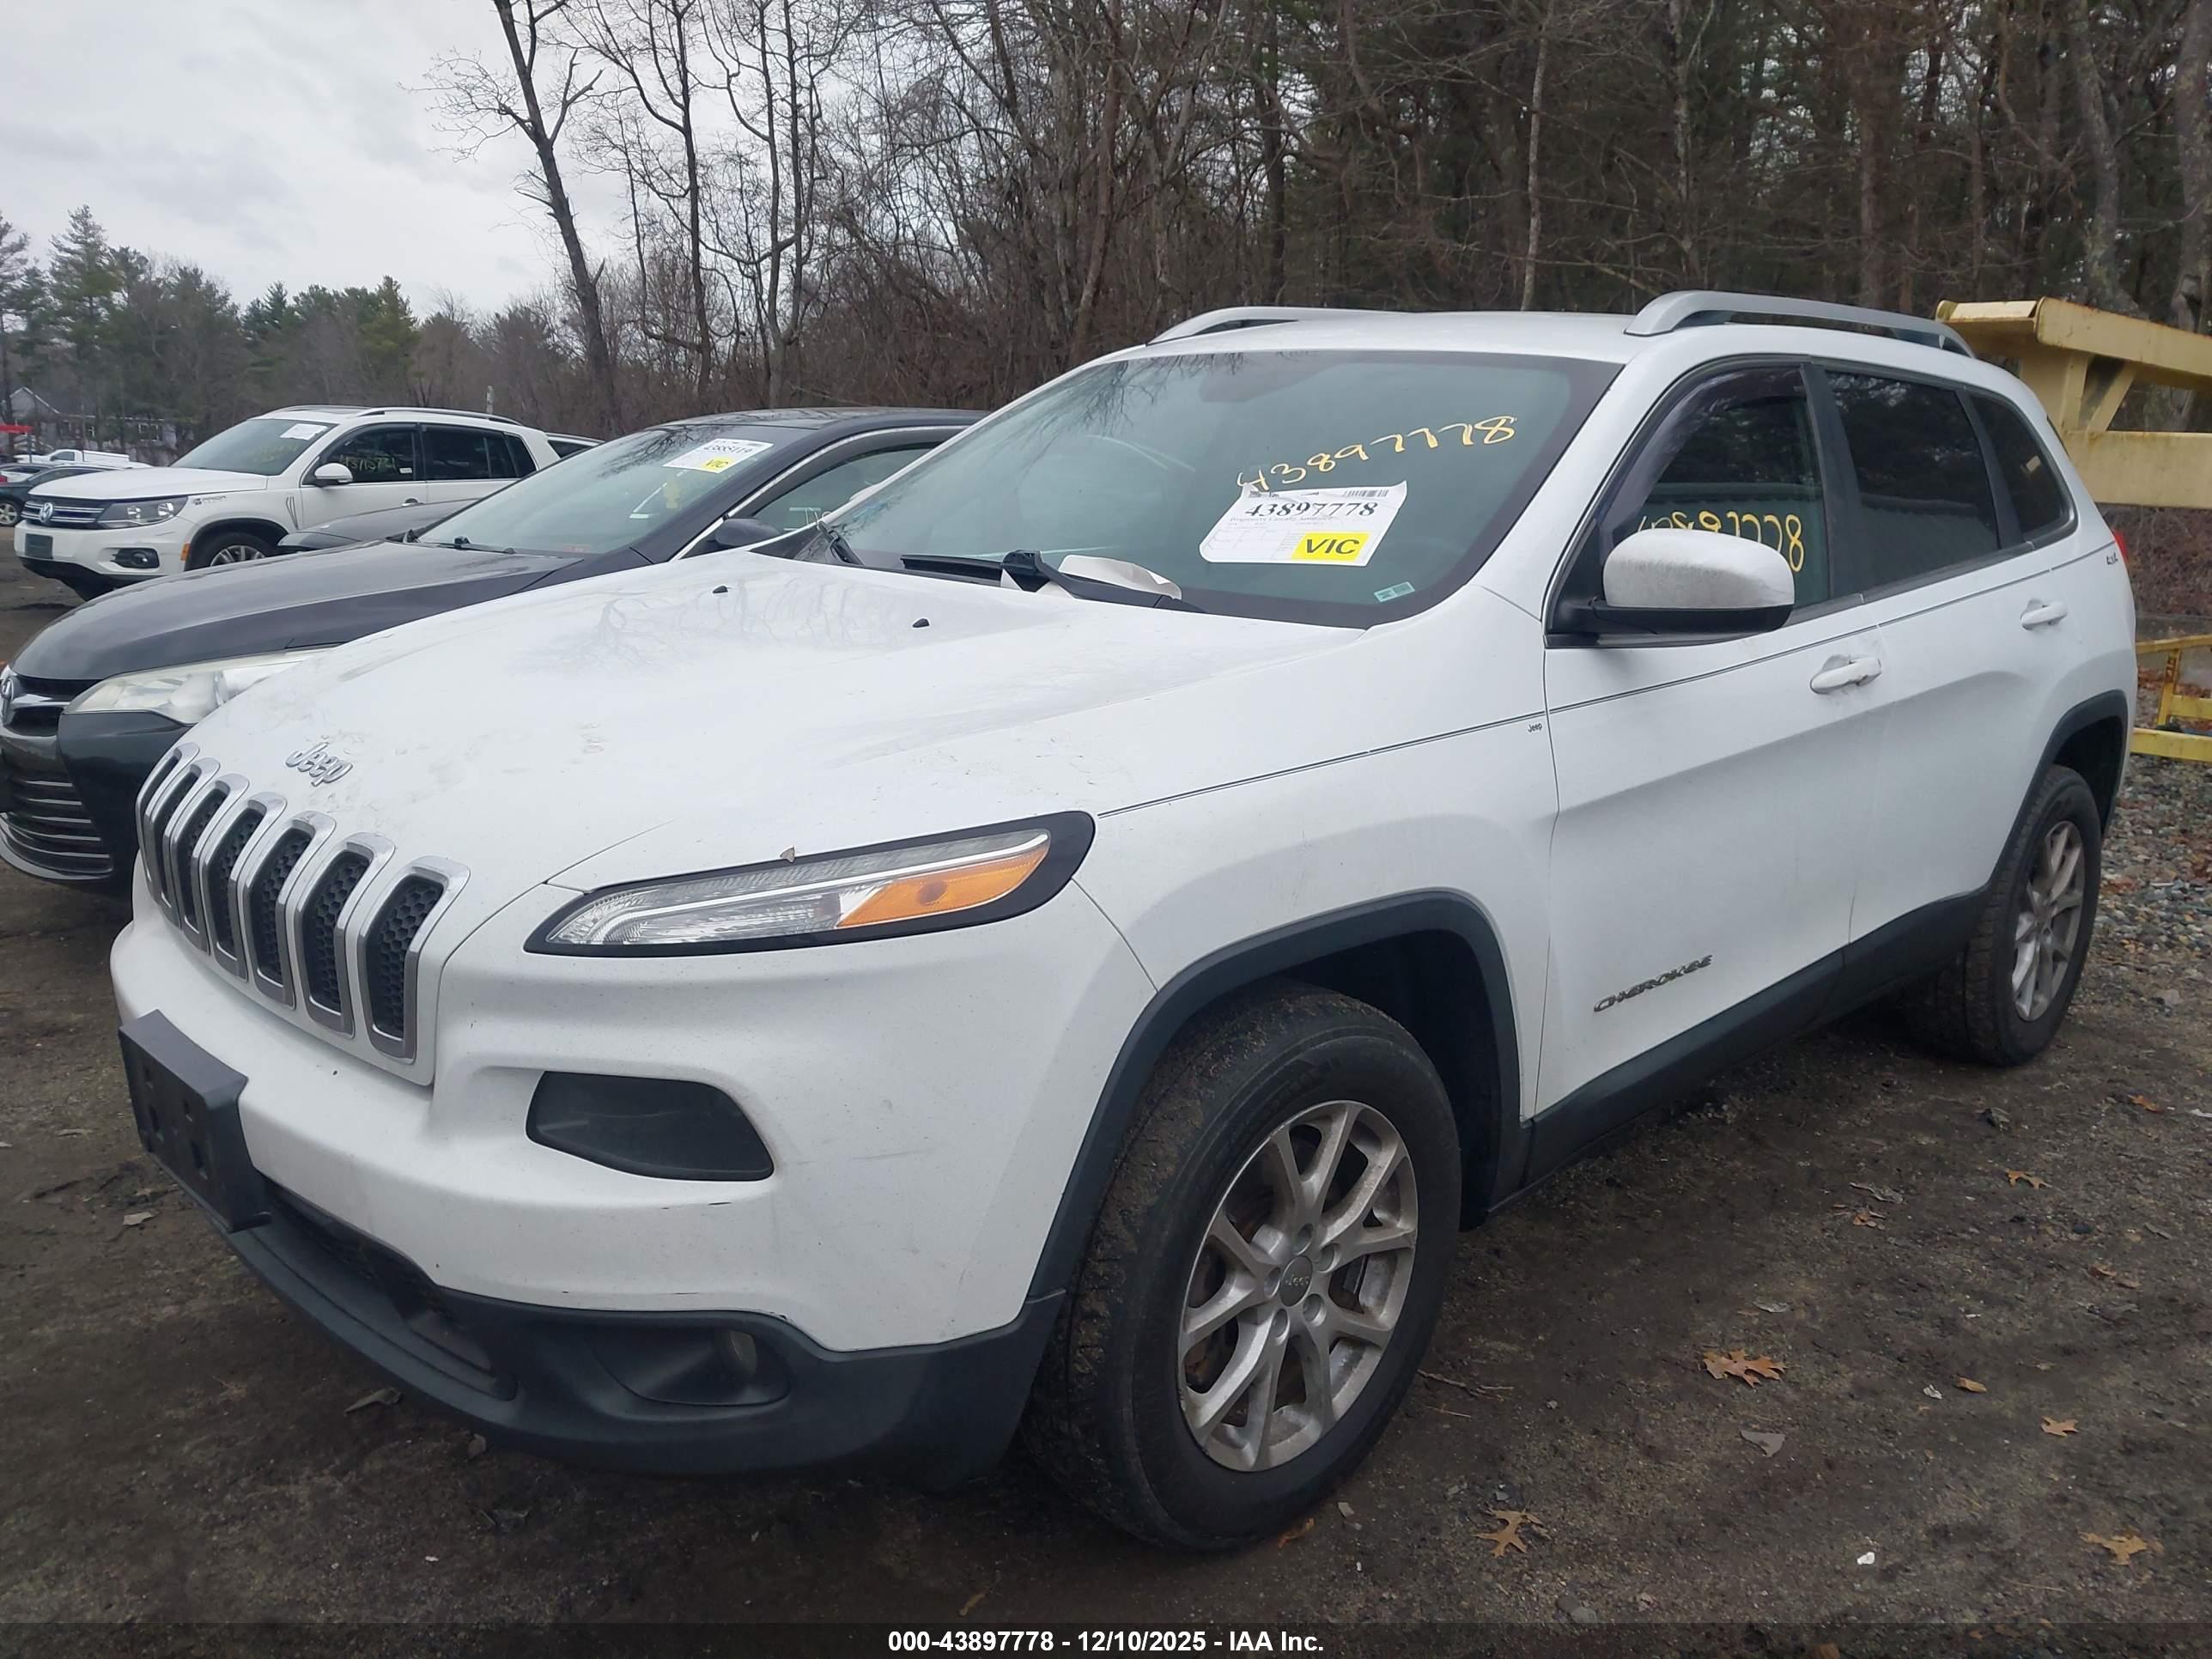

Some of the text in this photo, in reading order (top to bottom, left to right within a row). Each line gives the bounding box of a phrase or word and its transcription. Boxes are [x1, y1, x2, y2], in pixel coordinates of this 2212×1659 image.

[1237, 415, 1518, 492] 43897778
[1244, 501, 1379, 518] 43897778
[1305, 538, 1360, 555] VIC
[285, 741, 354, 787] Jeep
[1593, 954, 1714, 1013] CHEROKEE
